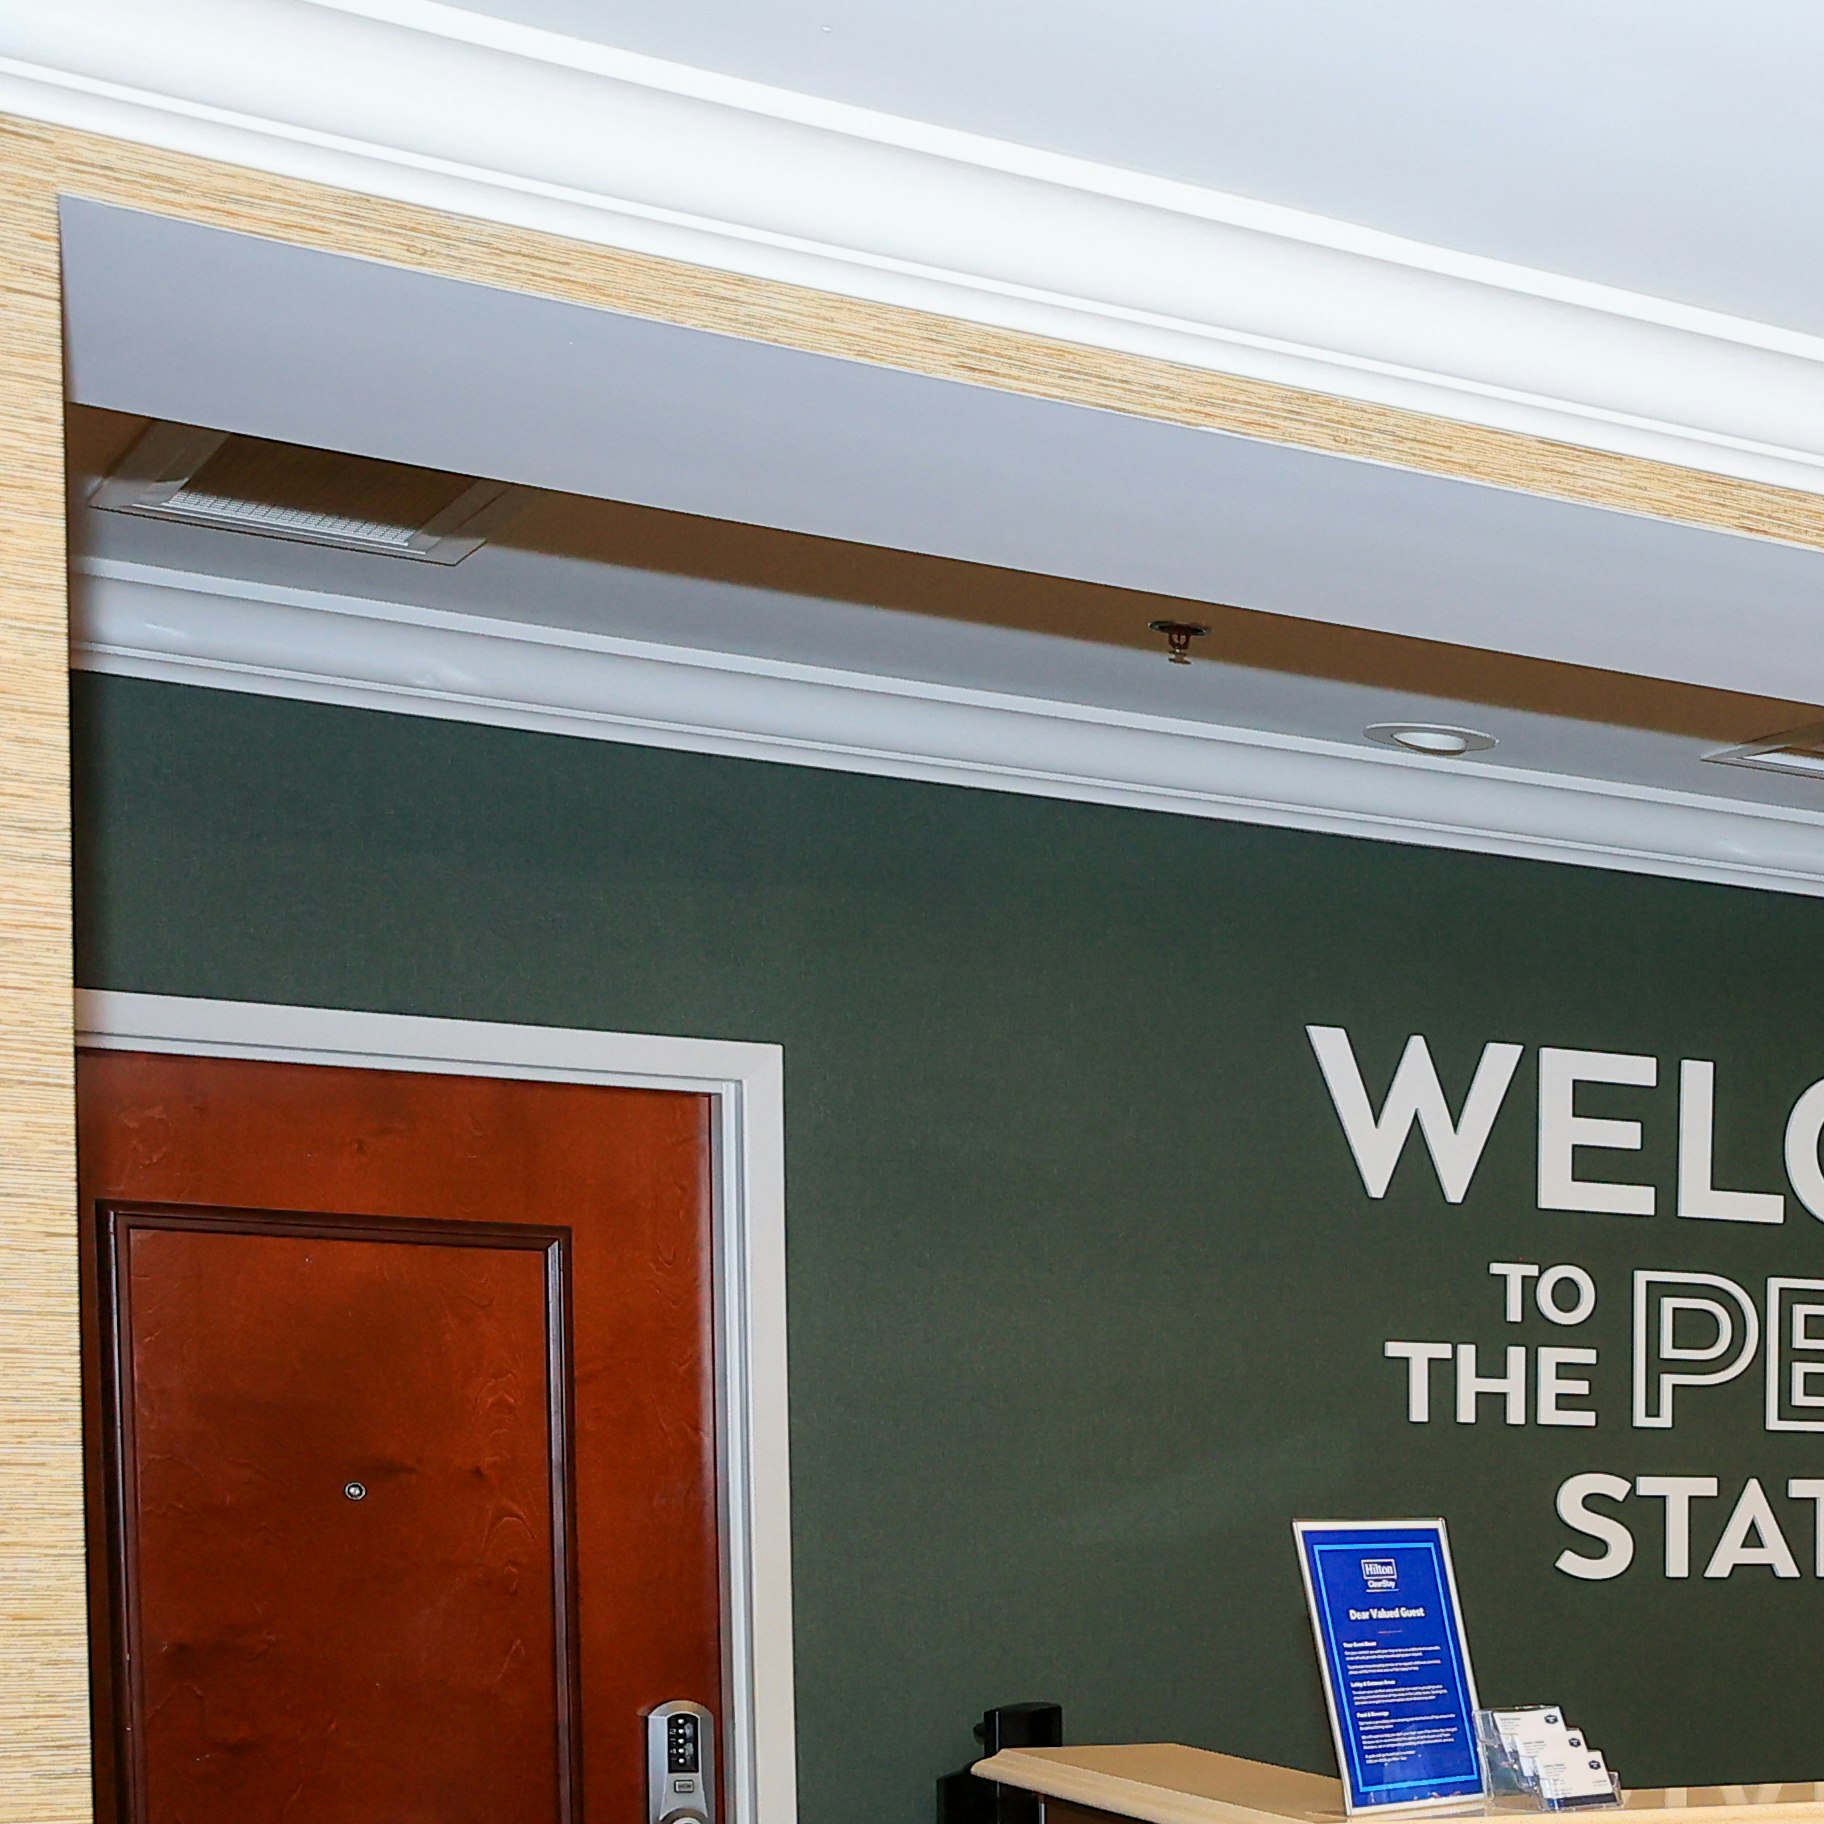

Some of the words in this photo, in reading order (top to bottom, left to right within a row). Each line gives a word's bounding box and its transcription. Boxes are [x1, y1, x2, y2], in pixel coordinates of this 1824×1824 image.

[1489, 1262, 1596, 1325] TO
[1384, 1341, 1597, 1427] THE
[1364, 1563, 1393, 1575] Hilton
[1348, 1609, 1370, 1621] Dear
[1370, 1607, 1400, 1620] Valued
[1400, 1606, 1426, 1618] Guest
